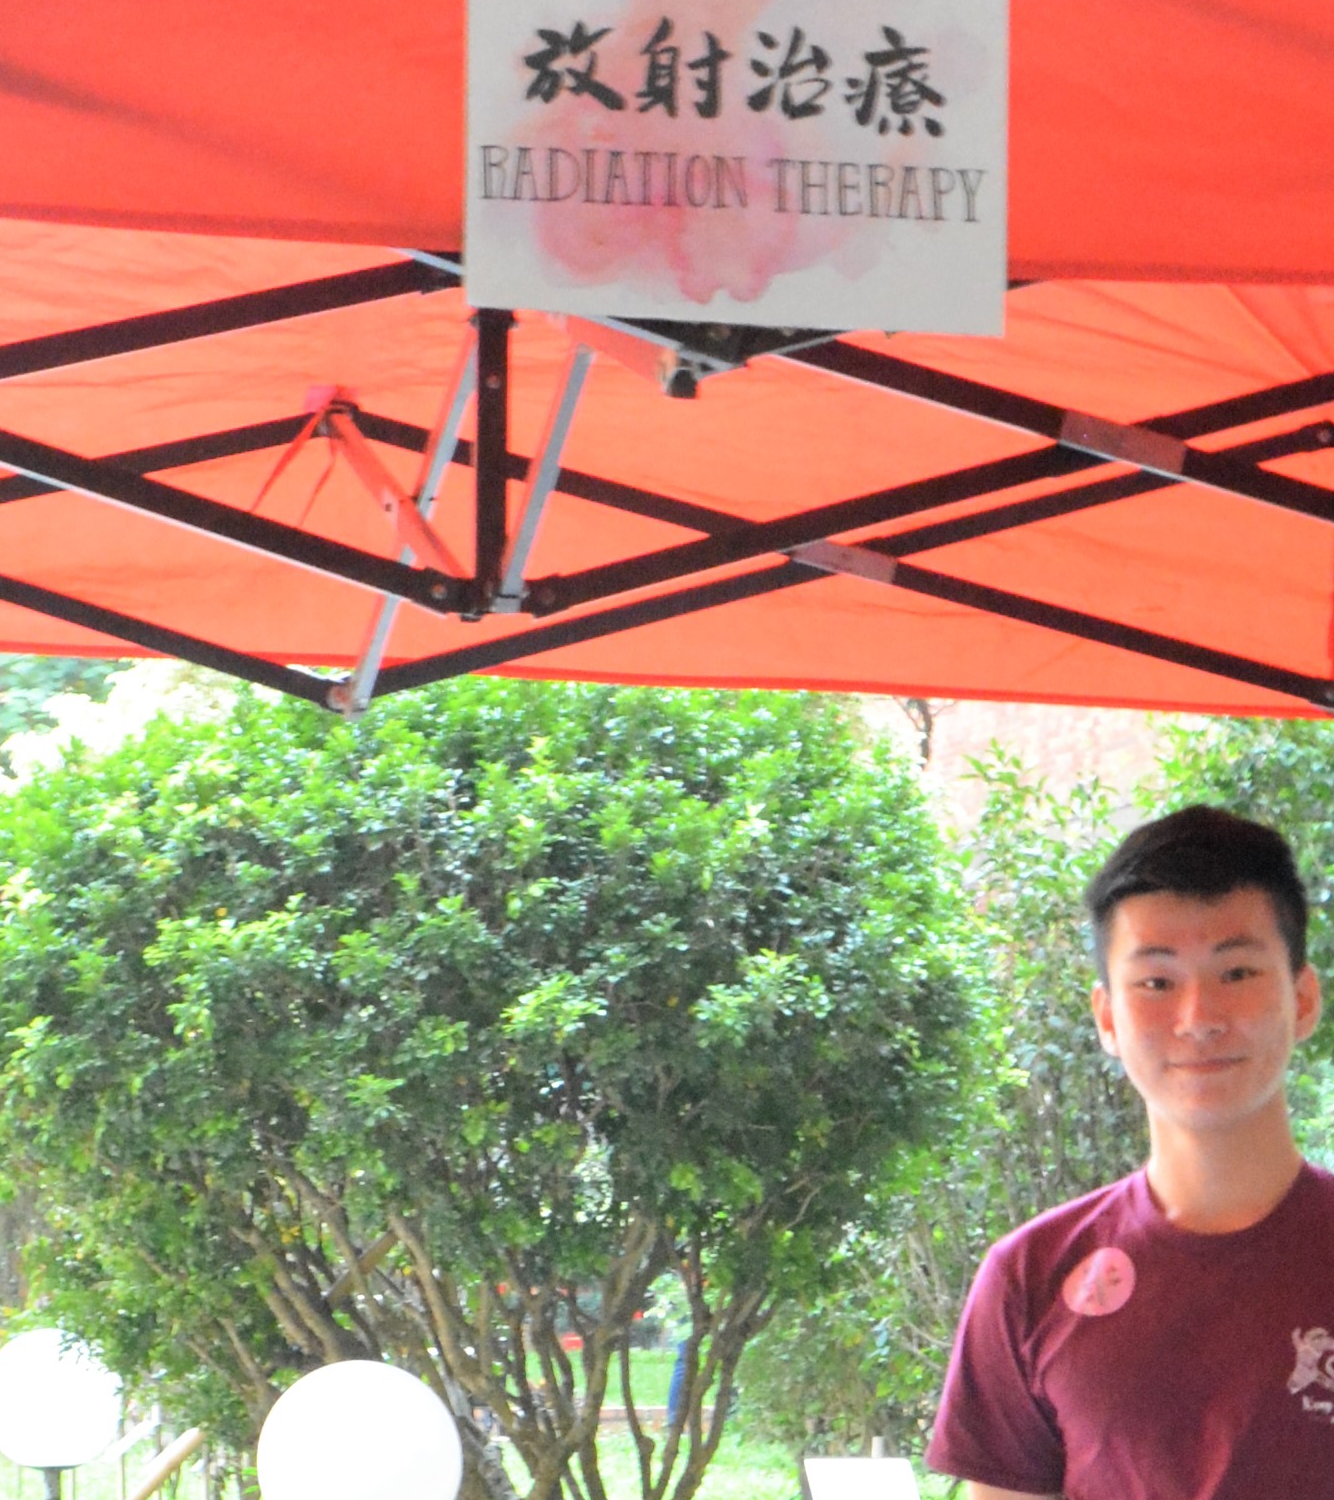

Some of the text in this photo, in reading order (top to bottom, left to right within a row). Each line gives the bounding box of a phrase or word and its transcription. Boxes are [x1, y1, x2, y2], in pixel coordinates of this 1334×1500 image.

[521, 17, 948, 138] 放射治療
[480, 144, 989, 223] RADIATION THERAPY
